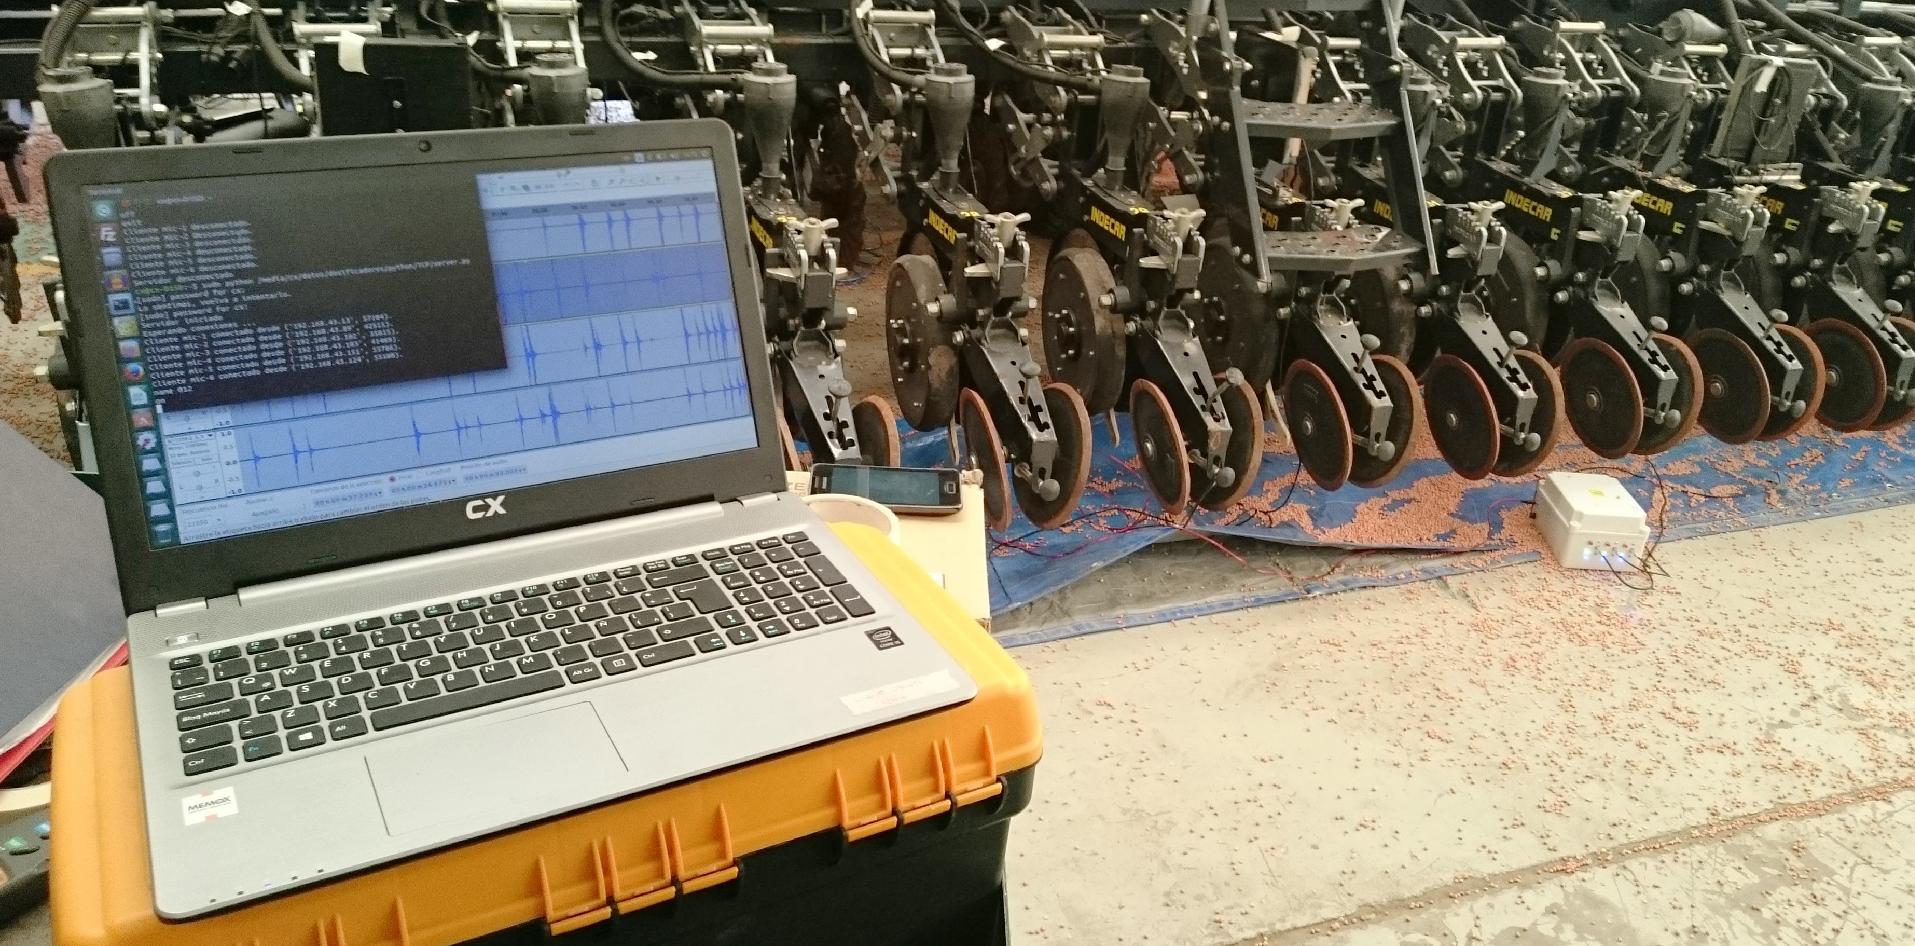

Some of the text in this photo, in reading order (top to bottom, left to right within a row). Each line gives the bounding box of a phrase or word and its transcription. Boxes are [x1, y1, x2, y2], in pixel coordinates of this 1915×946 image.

[1504, 189, 1553, 222] INDECAR
[1091, 205, 1127, 241] INDECAR
[169, 290, 208, 301] password
[144, 335, 178, 345] Cliente
[182, 332, 206, 341] mic-1
[210, 328, 253, 338] conectado
[256, 325, 280, 333] desde
[145, 344, 180, 353] Cliente
[183, 341, 208, 349] mic-2
[212, 336, 254, 346] conectado
[258, 333, 282, 341] desde
[147, 352, 181, 362] Cliente
[185, 349, 210, 358] mic-3
[213, 344, 256, 354] conectado
[259, 341, 283, 350] desde
[148, 360, 183, 370] Cliente
[187, 357, 211, 366] mic-4
[215, 352, 257, 363] conectado
[261, 349, 284, 358] desde
[150, 368, 185, 378] Cliente
[188, 365, 213, 374] mic-5
[216, 360, 259, 371] conectado
[262, 357, 286, 366] desde
[152, 377, 186, 387] Cliente
[190, 374, 214, 382] mic-6
[218, 368, 260, 379] conectado
[264, 365, 288, 374] desde
[466, 494, 507, 520] CX
[182, 714, 201, 722] Bloq
[187, 796, 232, 811] MEMOX
